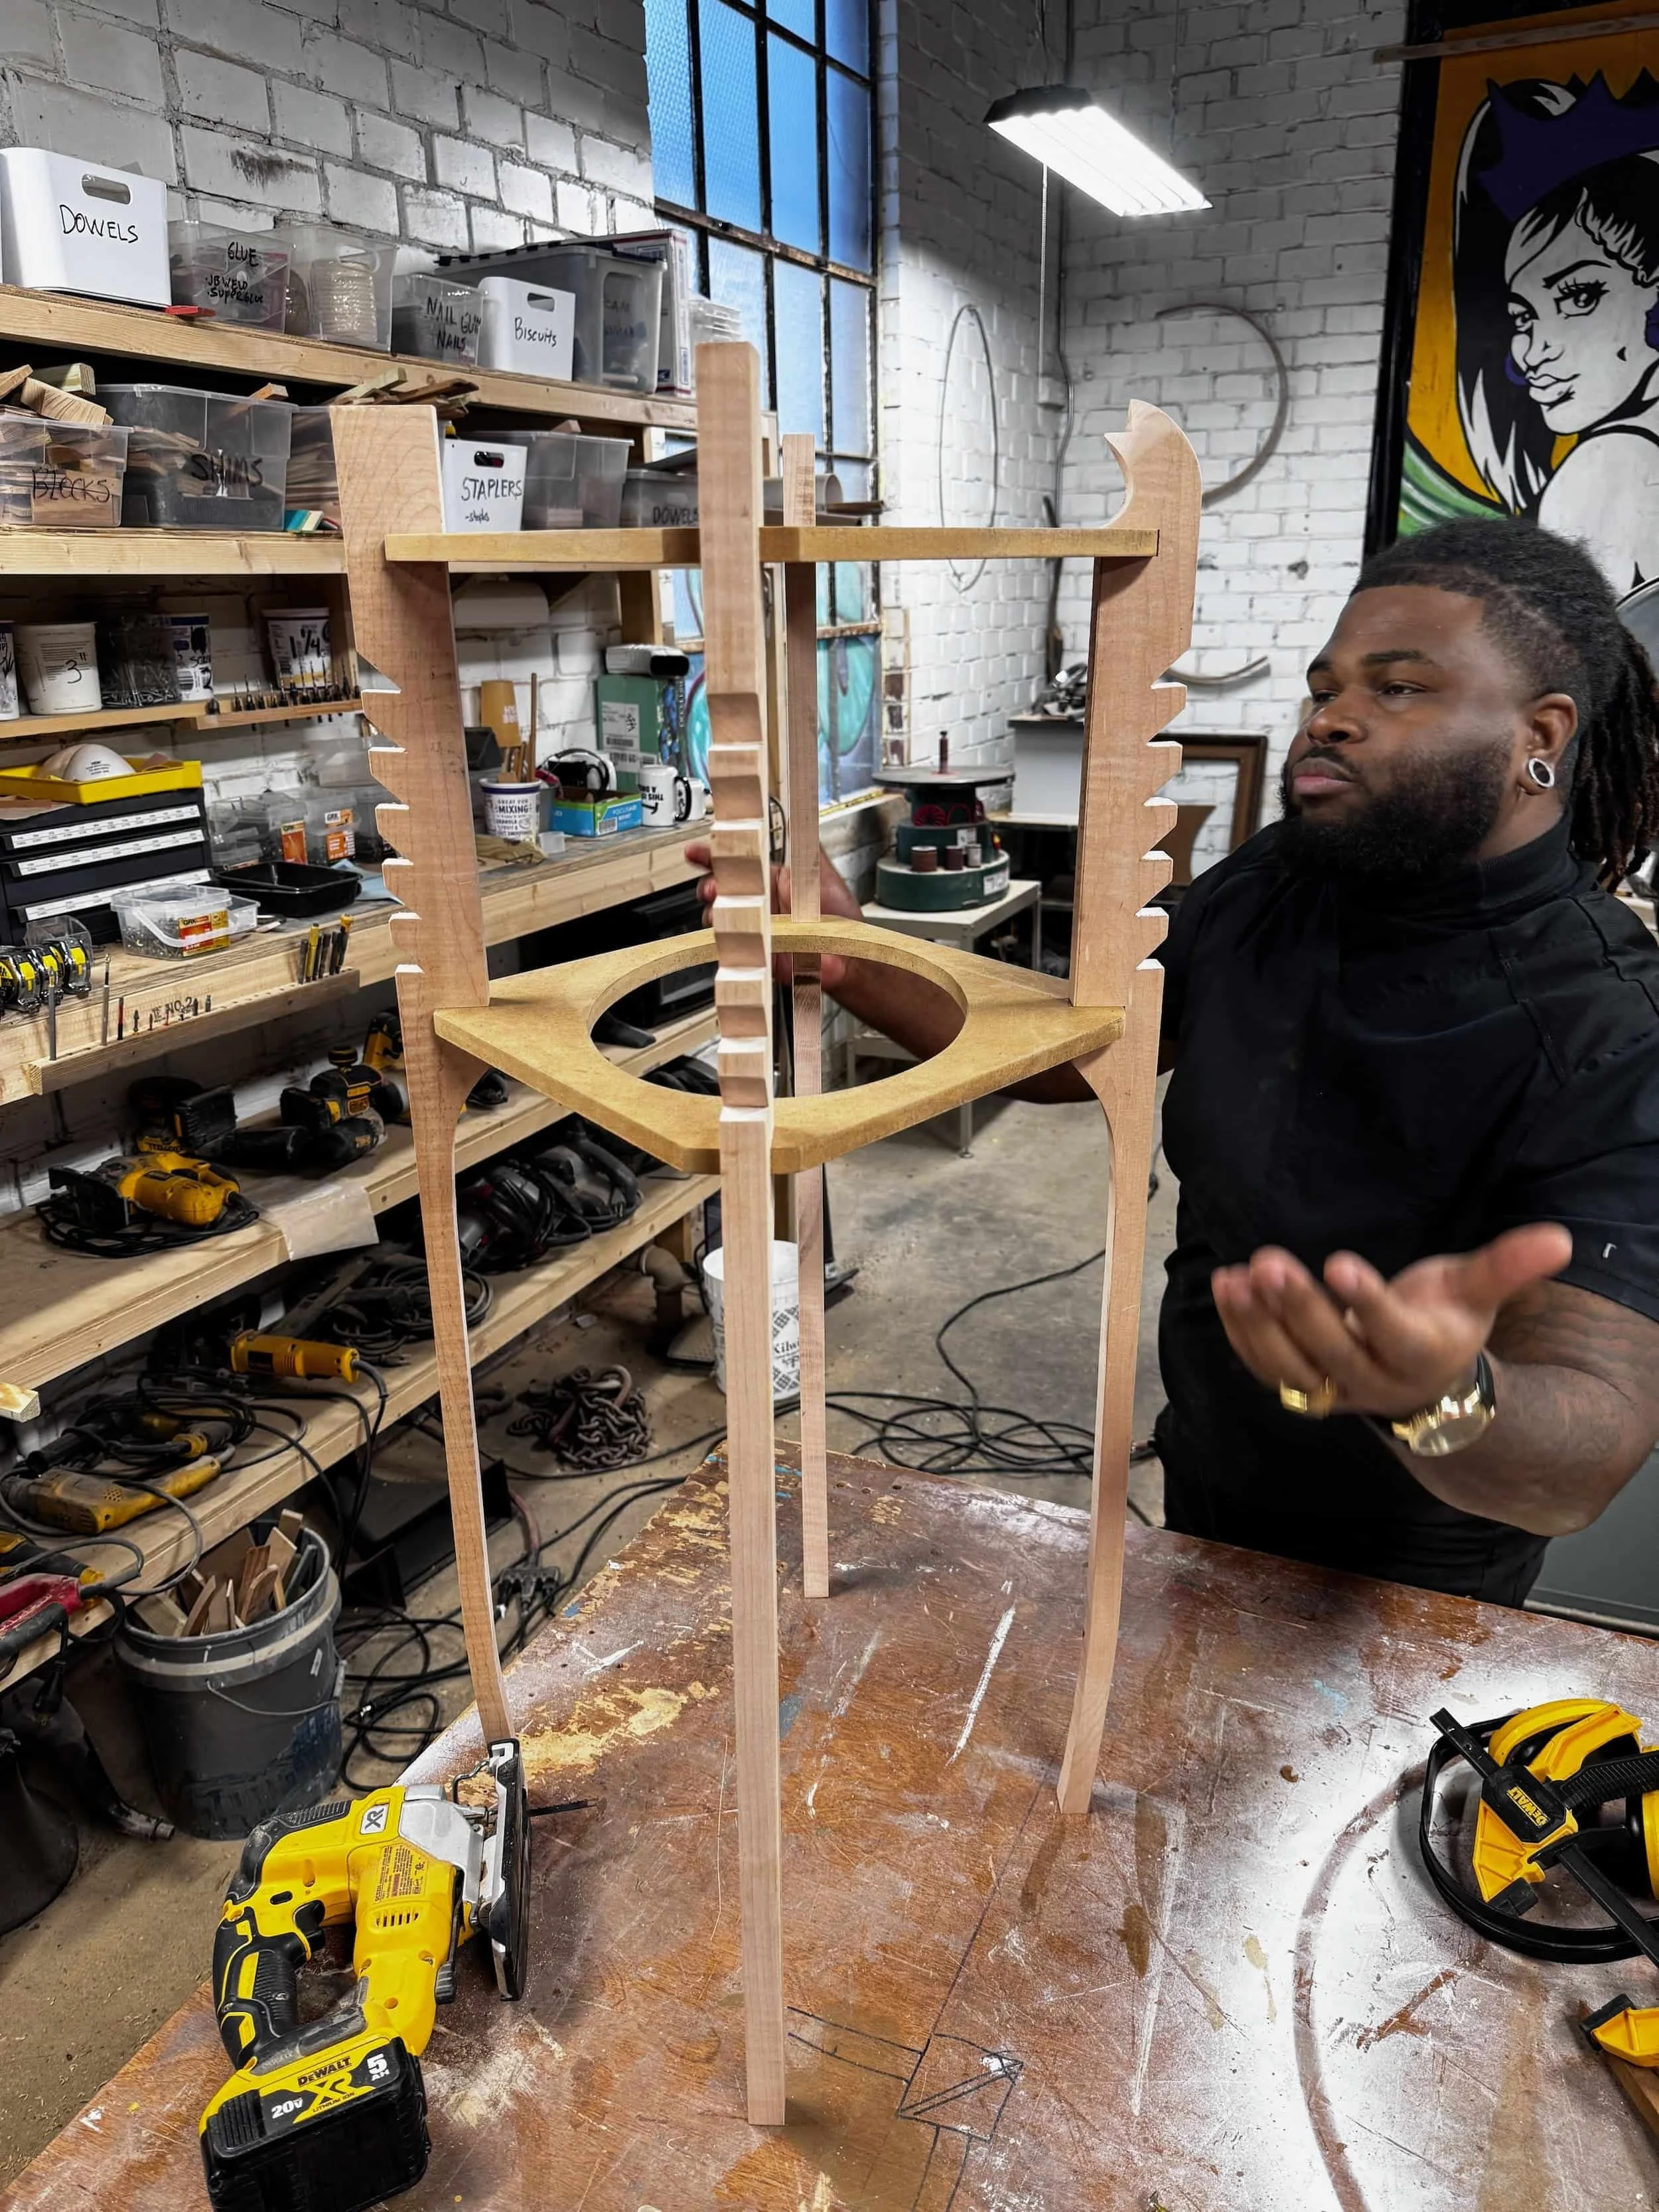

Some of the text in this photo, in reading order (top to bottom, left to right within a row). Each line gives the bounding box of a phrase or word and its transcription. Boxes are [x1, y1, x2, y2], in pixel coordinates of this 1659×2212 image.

[59, 204, 138, 243] DOWELS
[228, 242, 259, 267] GLUE
[222, 277, 248, 290] WELD
[426, 297, 457, 324] NAIL
[437, 330, 466, 351] NAILS
[191, 453, 263, 486] SHIMS
[461, 476, 523, 501] STAPLERS
[498, 805, 529, 813] MIXING
[364, 1807, 384, 1830] XR
[1507, 1787, 1549, 1827] DEWALT
[298, 2057, 352, 2087] DEWALT
[366, 2053, 388, 2075] 5
[313, 2091, 355, 2113] LITHIUM ION
